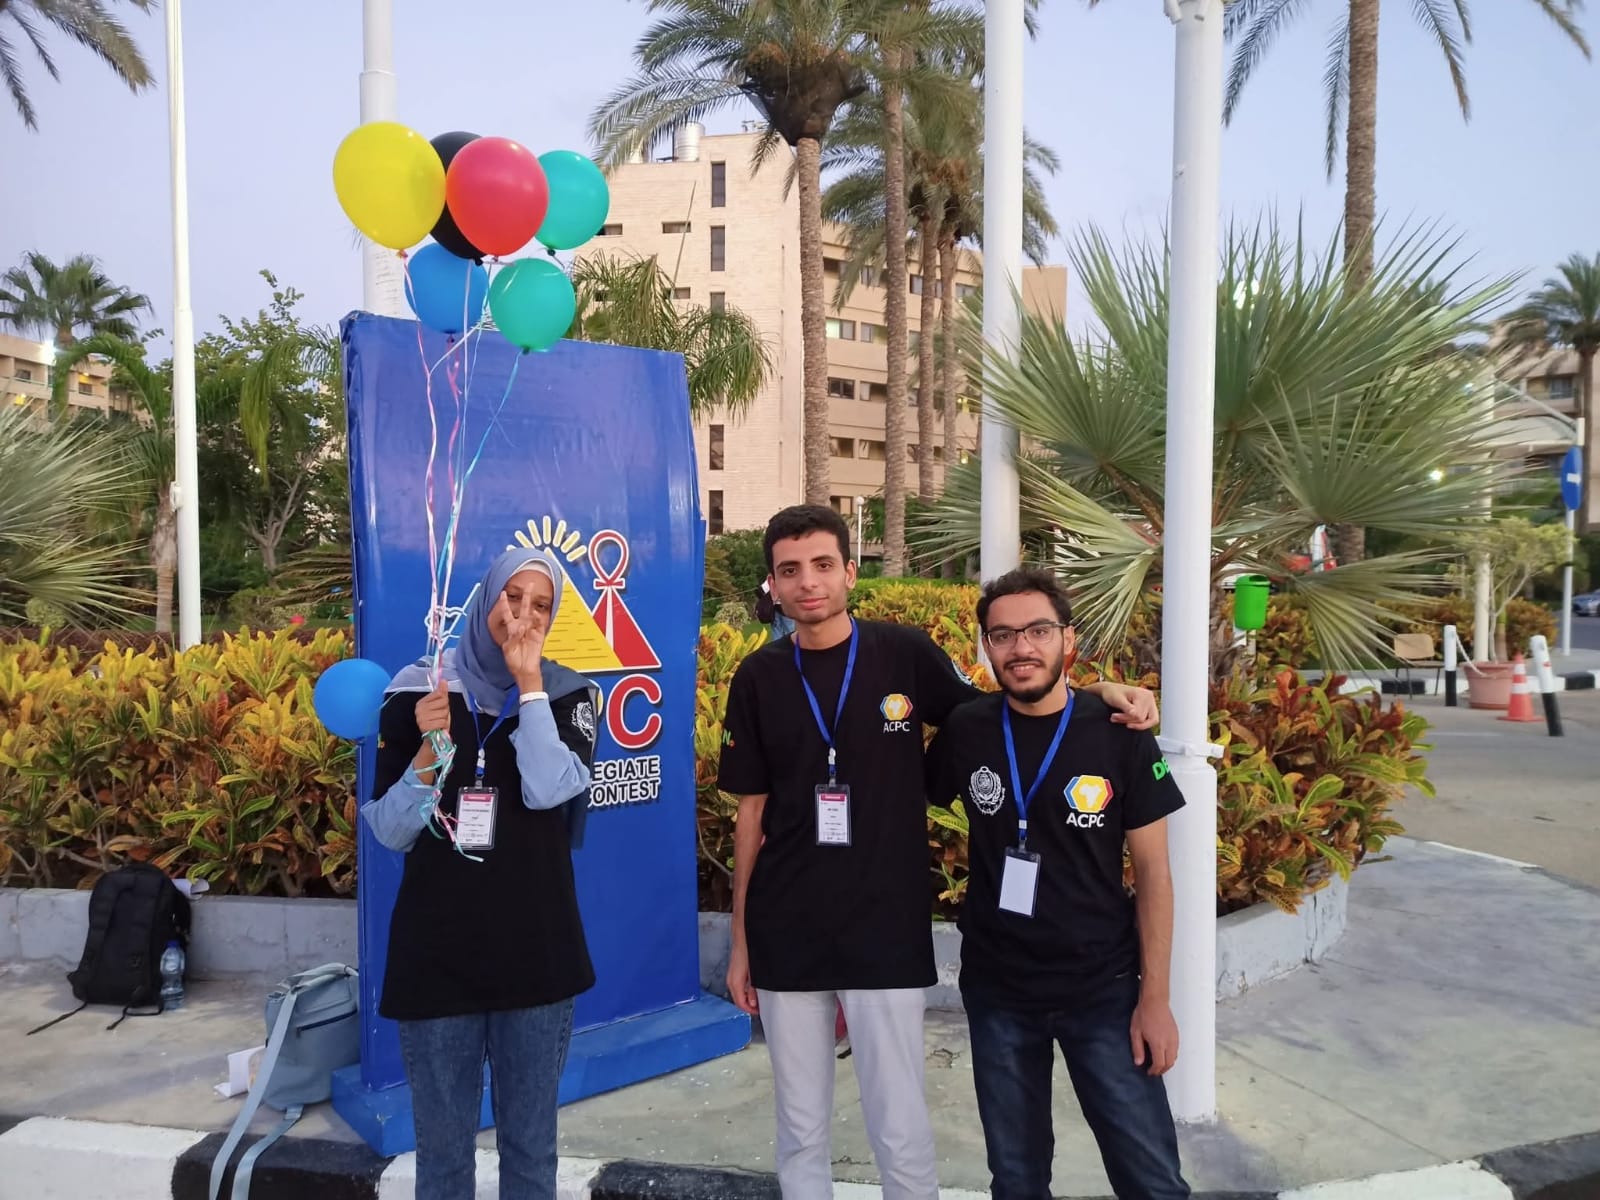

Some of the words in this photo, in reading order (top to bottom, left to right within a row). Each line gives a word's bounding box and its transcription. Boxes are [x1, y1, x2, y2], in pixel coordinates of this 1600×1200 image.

[597, 673, 662, 749] C
[883, 721, 911, 734] ACPC
[592, 755, 661, 782] EGIATE
[588, 778, 661, 808] ONTEST
[1065, 811, 1105, 829] ACPC
